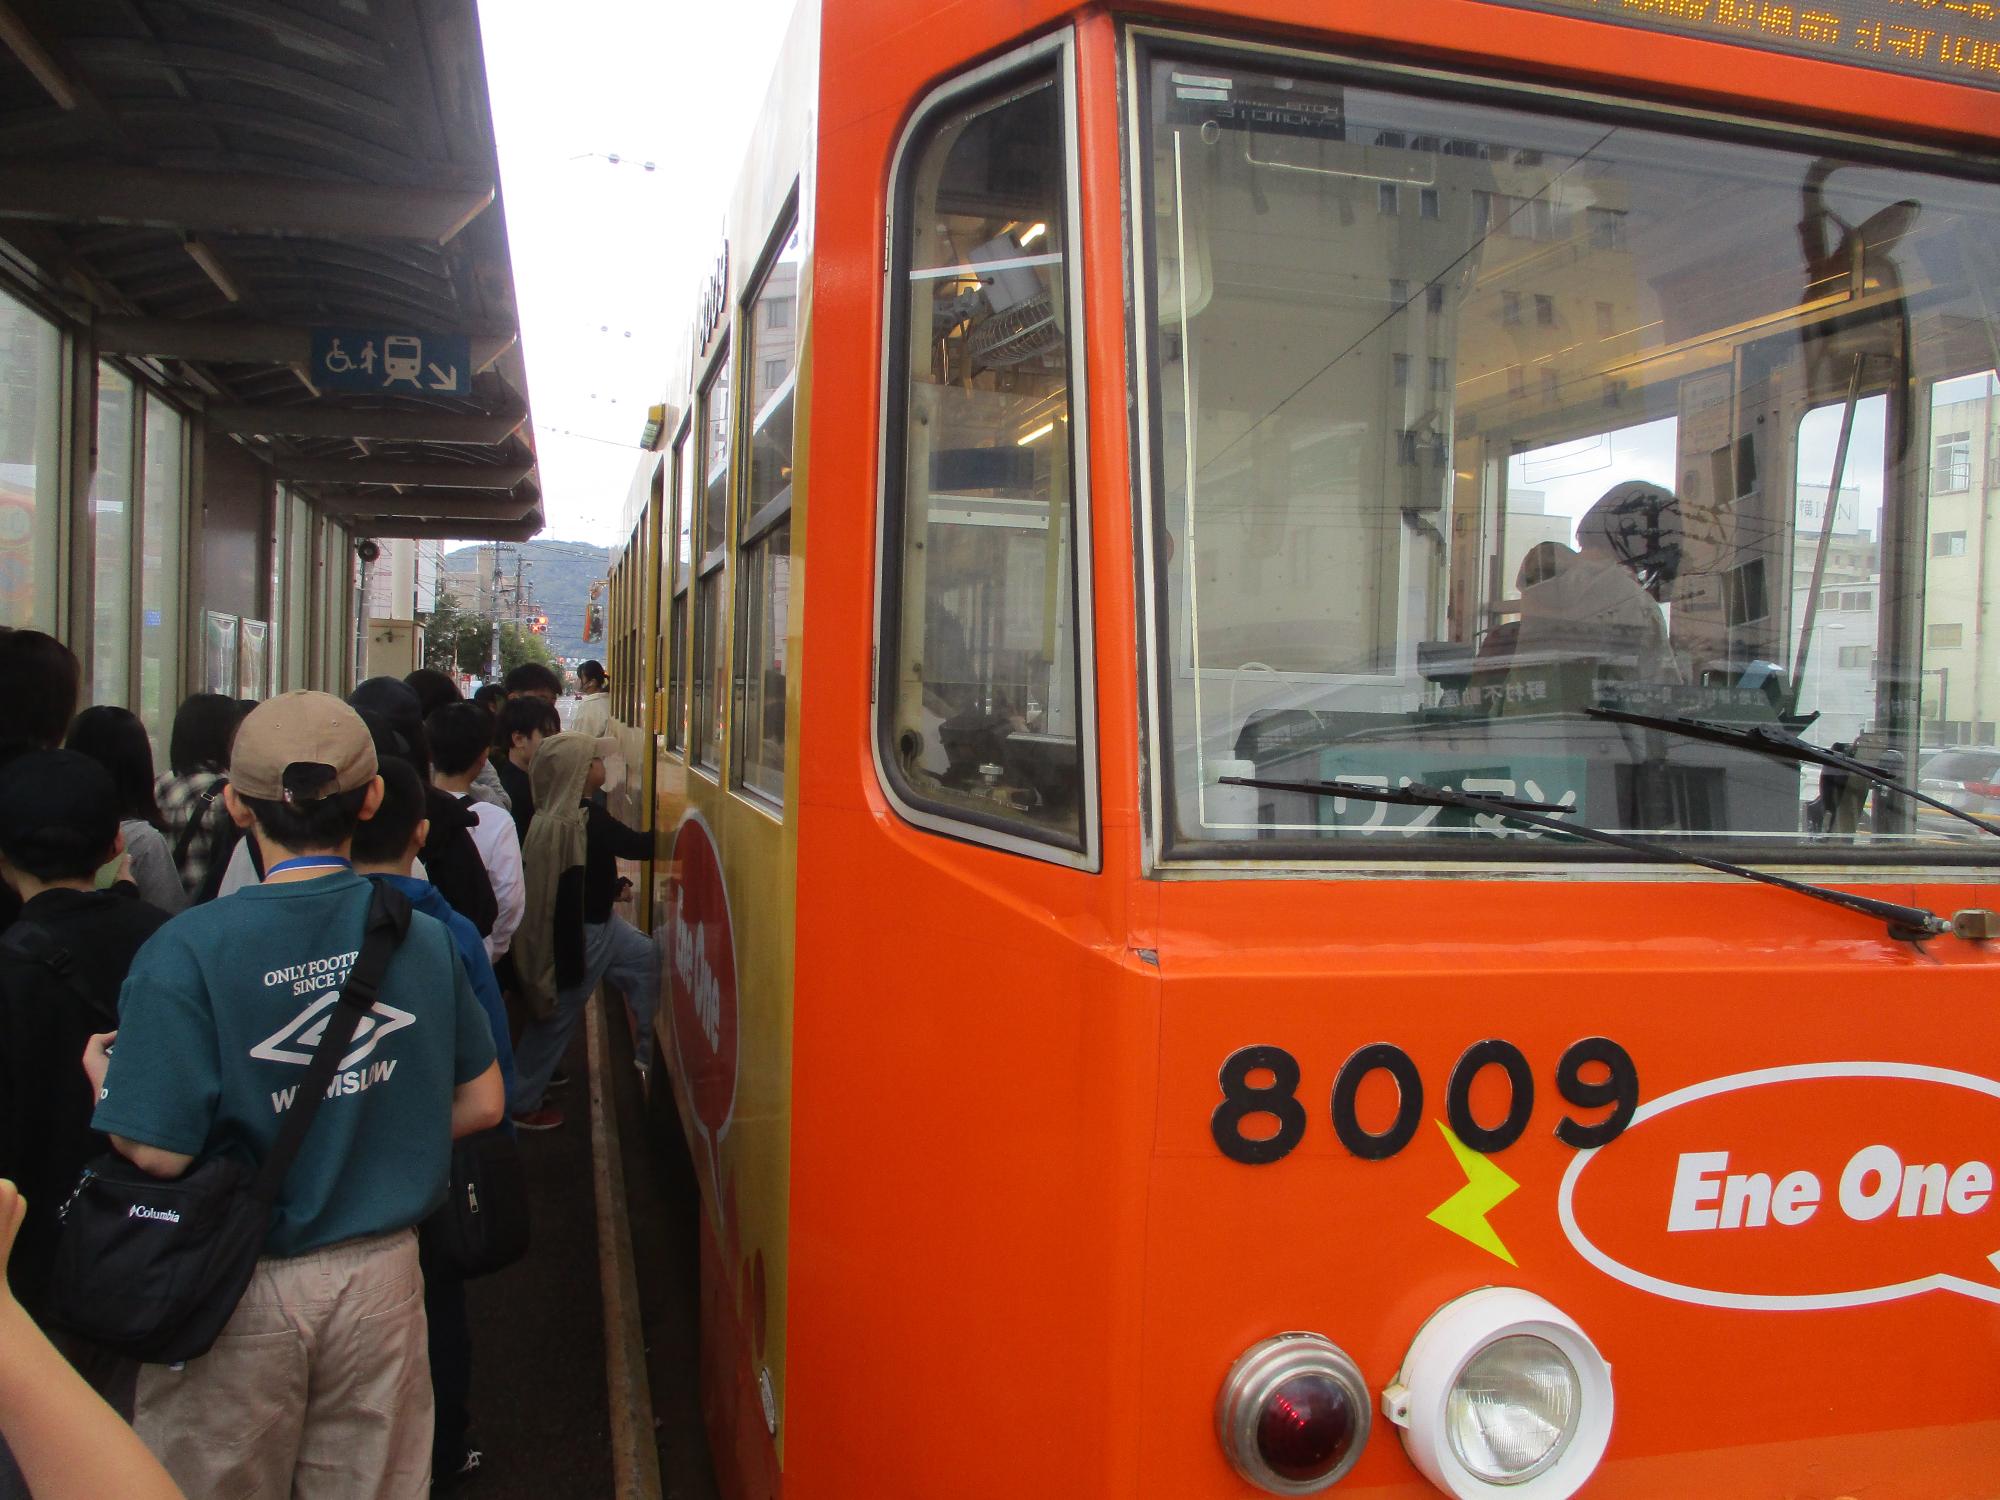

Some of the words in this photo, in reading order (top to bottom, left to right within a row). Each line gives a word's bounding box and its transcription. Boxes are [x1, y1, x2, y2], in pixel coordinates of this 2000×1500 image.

[1333, 775, 1577, 839] ワンマン
[264, 964, 306, 987] ONLY
[293, 973, 336, 996] SINCE
[1211, 1036, 1640, 1165] 8009
[1667, 1151, 1821, 1233] Ene
[1839, 1144, 1993, 1219] One
[134, 1204, 180, 1223] Columbia
